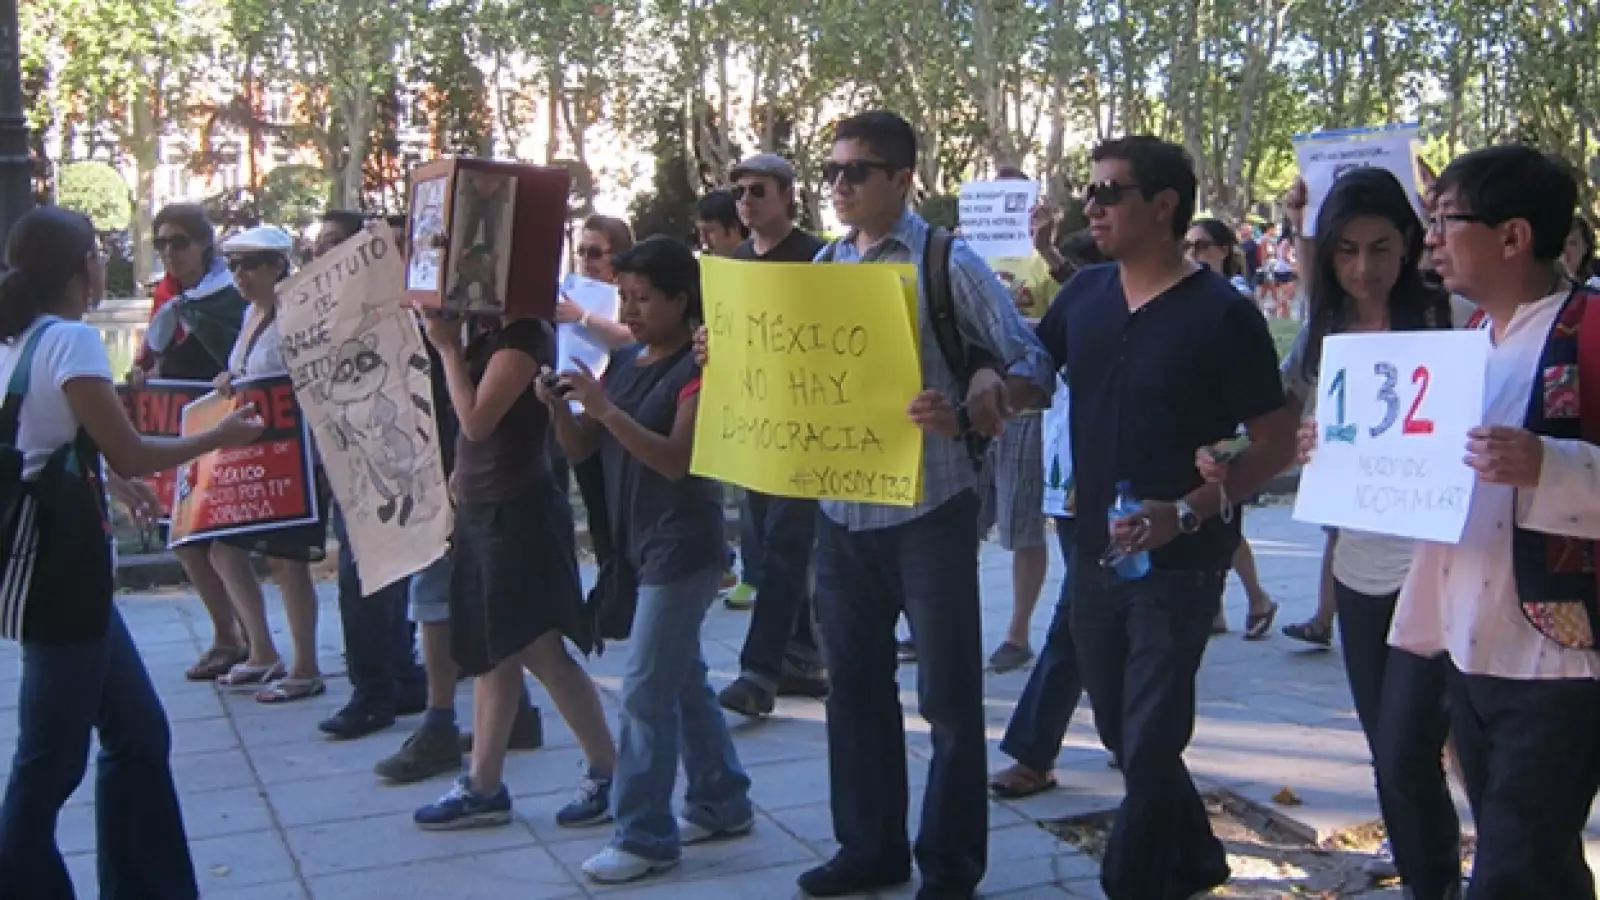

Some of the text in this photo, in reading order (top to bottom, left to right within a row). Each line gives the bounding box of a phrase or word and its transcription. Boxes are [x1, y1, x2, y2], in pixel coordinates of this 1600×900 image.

[739, 367, 851, 406] NO HAY
[1325, 361, 1434, 444] 132
